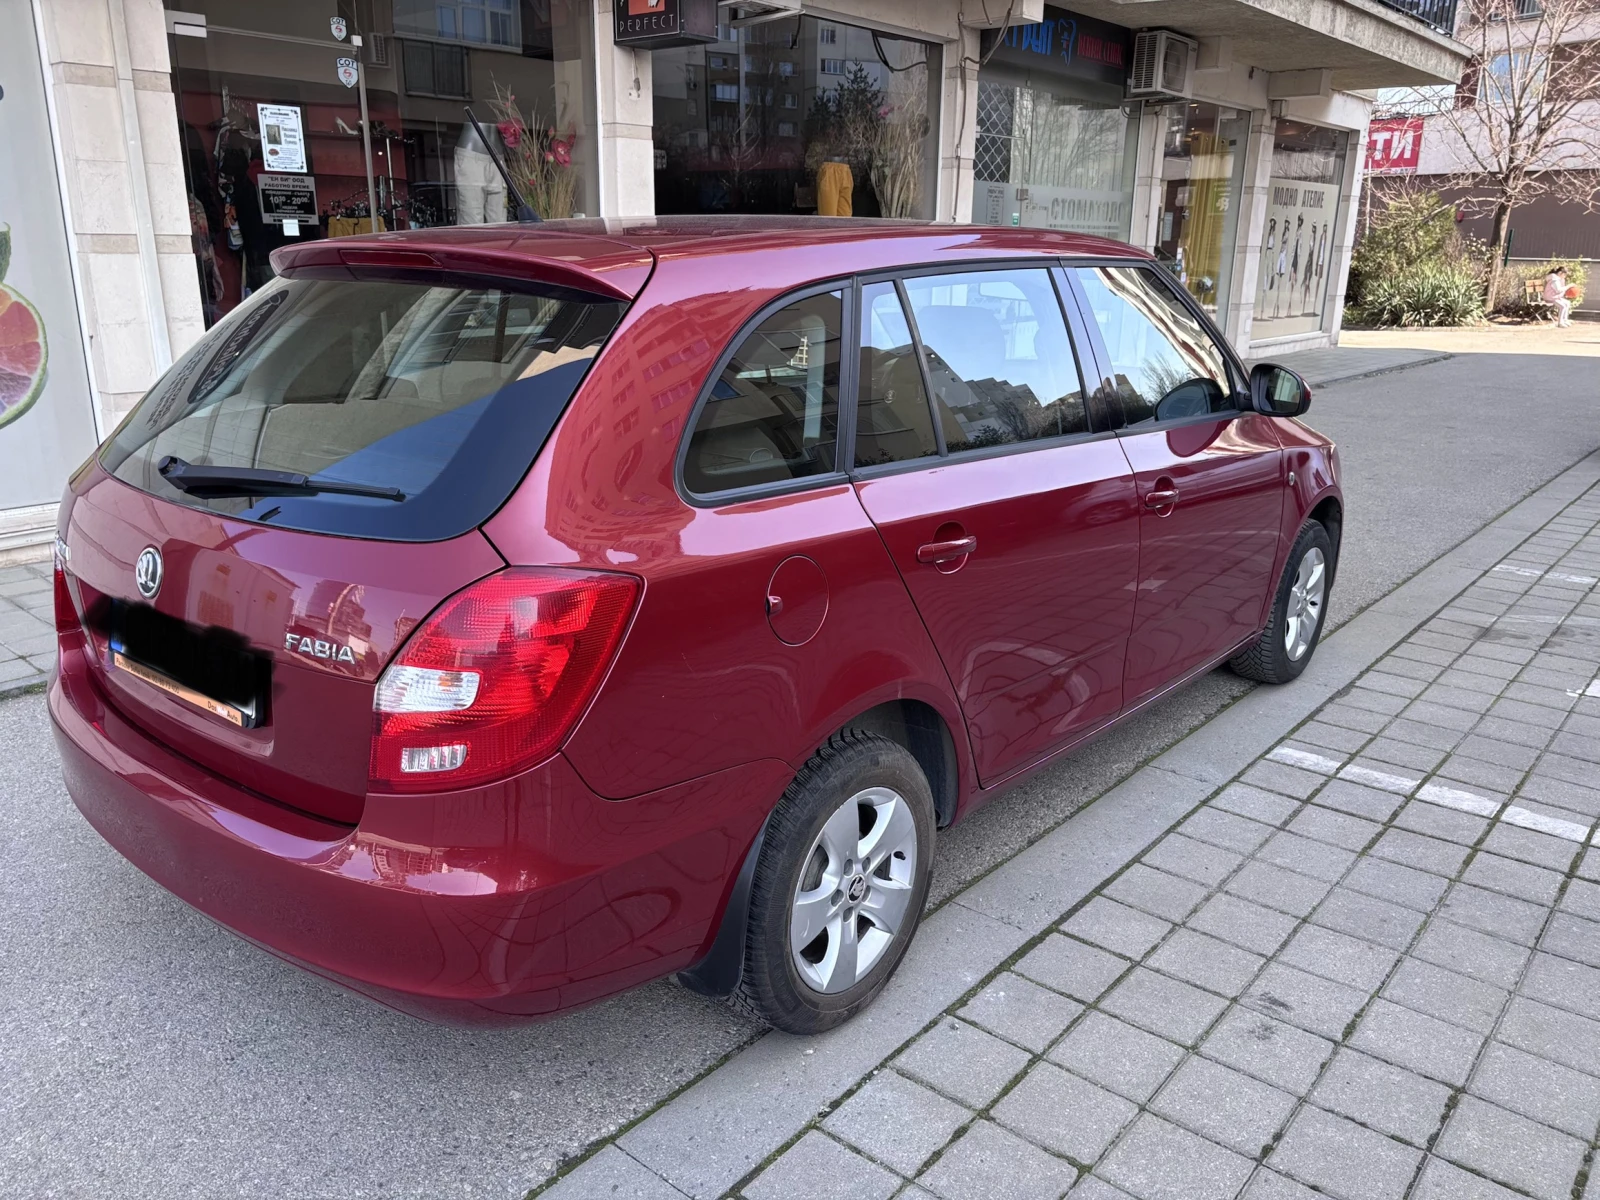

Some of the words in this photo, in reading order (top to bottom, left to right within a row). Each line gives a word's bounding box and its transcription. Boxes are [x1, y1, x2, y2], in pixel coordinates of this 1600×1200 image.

[620, 14, 674, 33] PERFECT
[1273, 186, 1299, 210] МОДНО
[1301, 189, 1325, 209] АТЕЛИЕ
[285, 633, 355, 665] FABIA
